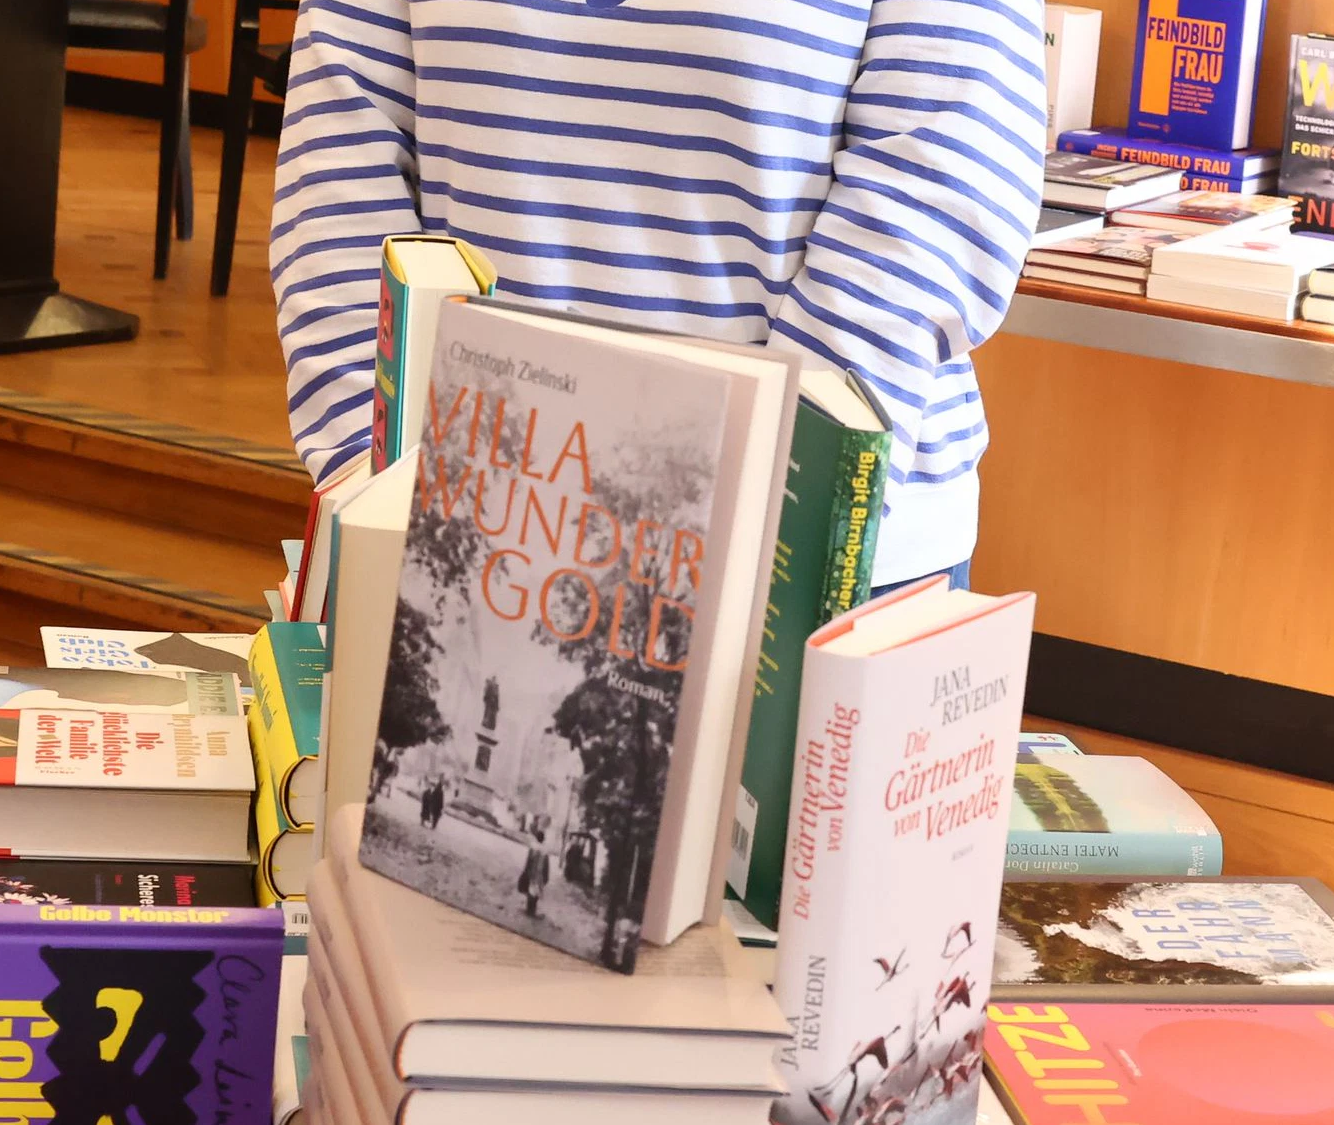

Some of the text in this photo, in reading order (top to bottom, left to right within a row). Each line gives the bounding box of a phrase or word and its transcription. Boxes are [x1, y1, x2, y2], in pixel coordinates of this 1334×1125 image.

[1147, 17, 1223, 49] FEINDBILD
[1301, 47, 1327, 58] CARL
[1174, 50, 1223, 84] FRAU
[1295, 124, 1309, 132] DAS
[1121, 147, 1230, 175] FEINDBILD FRAU
[1192, 177, 1229, 193] FRAU
[449, 341, 578, 394] Christoph Zielinski
[428, 380, 594, 495] VILLA
[418, 451, 705, 593] WUNDER
[838, 451, 876, 611] Birgit Birnbacher
[480, 549, 696, 671] GOLD
[606, 671, 667, 702] Roman
[931, 665, 971, 707] JANA
[942, 675, 1008, 727] REVEDIN
[35, 713, 58, 765] der Welt
[69, 719, 95, 760] Familie
[136, 731, 164, 751] Die
[904, 727, 931, 759] Die
[820, 702, 861, 852] von Venedig
[884, 734, 995, 811] Gärtnerin
[894, 774, 1005, 842] von Venedig
[792, 739, 826, 921] Die Gärtnerin
[1074, 844, 1120, 857] MATEI
[1034, 859, 1080, 872] Catalin
[173, 874, 194, 906] Marina
[40, 905, 229, 923] Gelbe Monster
[1132, 908, 1203, 950] DER
[1176, 900, 1261, 959] FÄHR
[1222, 899, 1308, 963] MANN
[780, 954, 828, 1071] JANA REVEDIN
[987, 1004, 1139, 1125] HITZE
